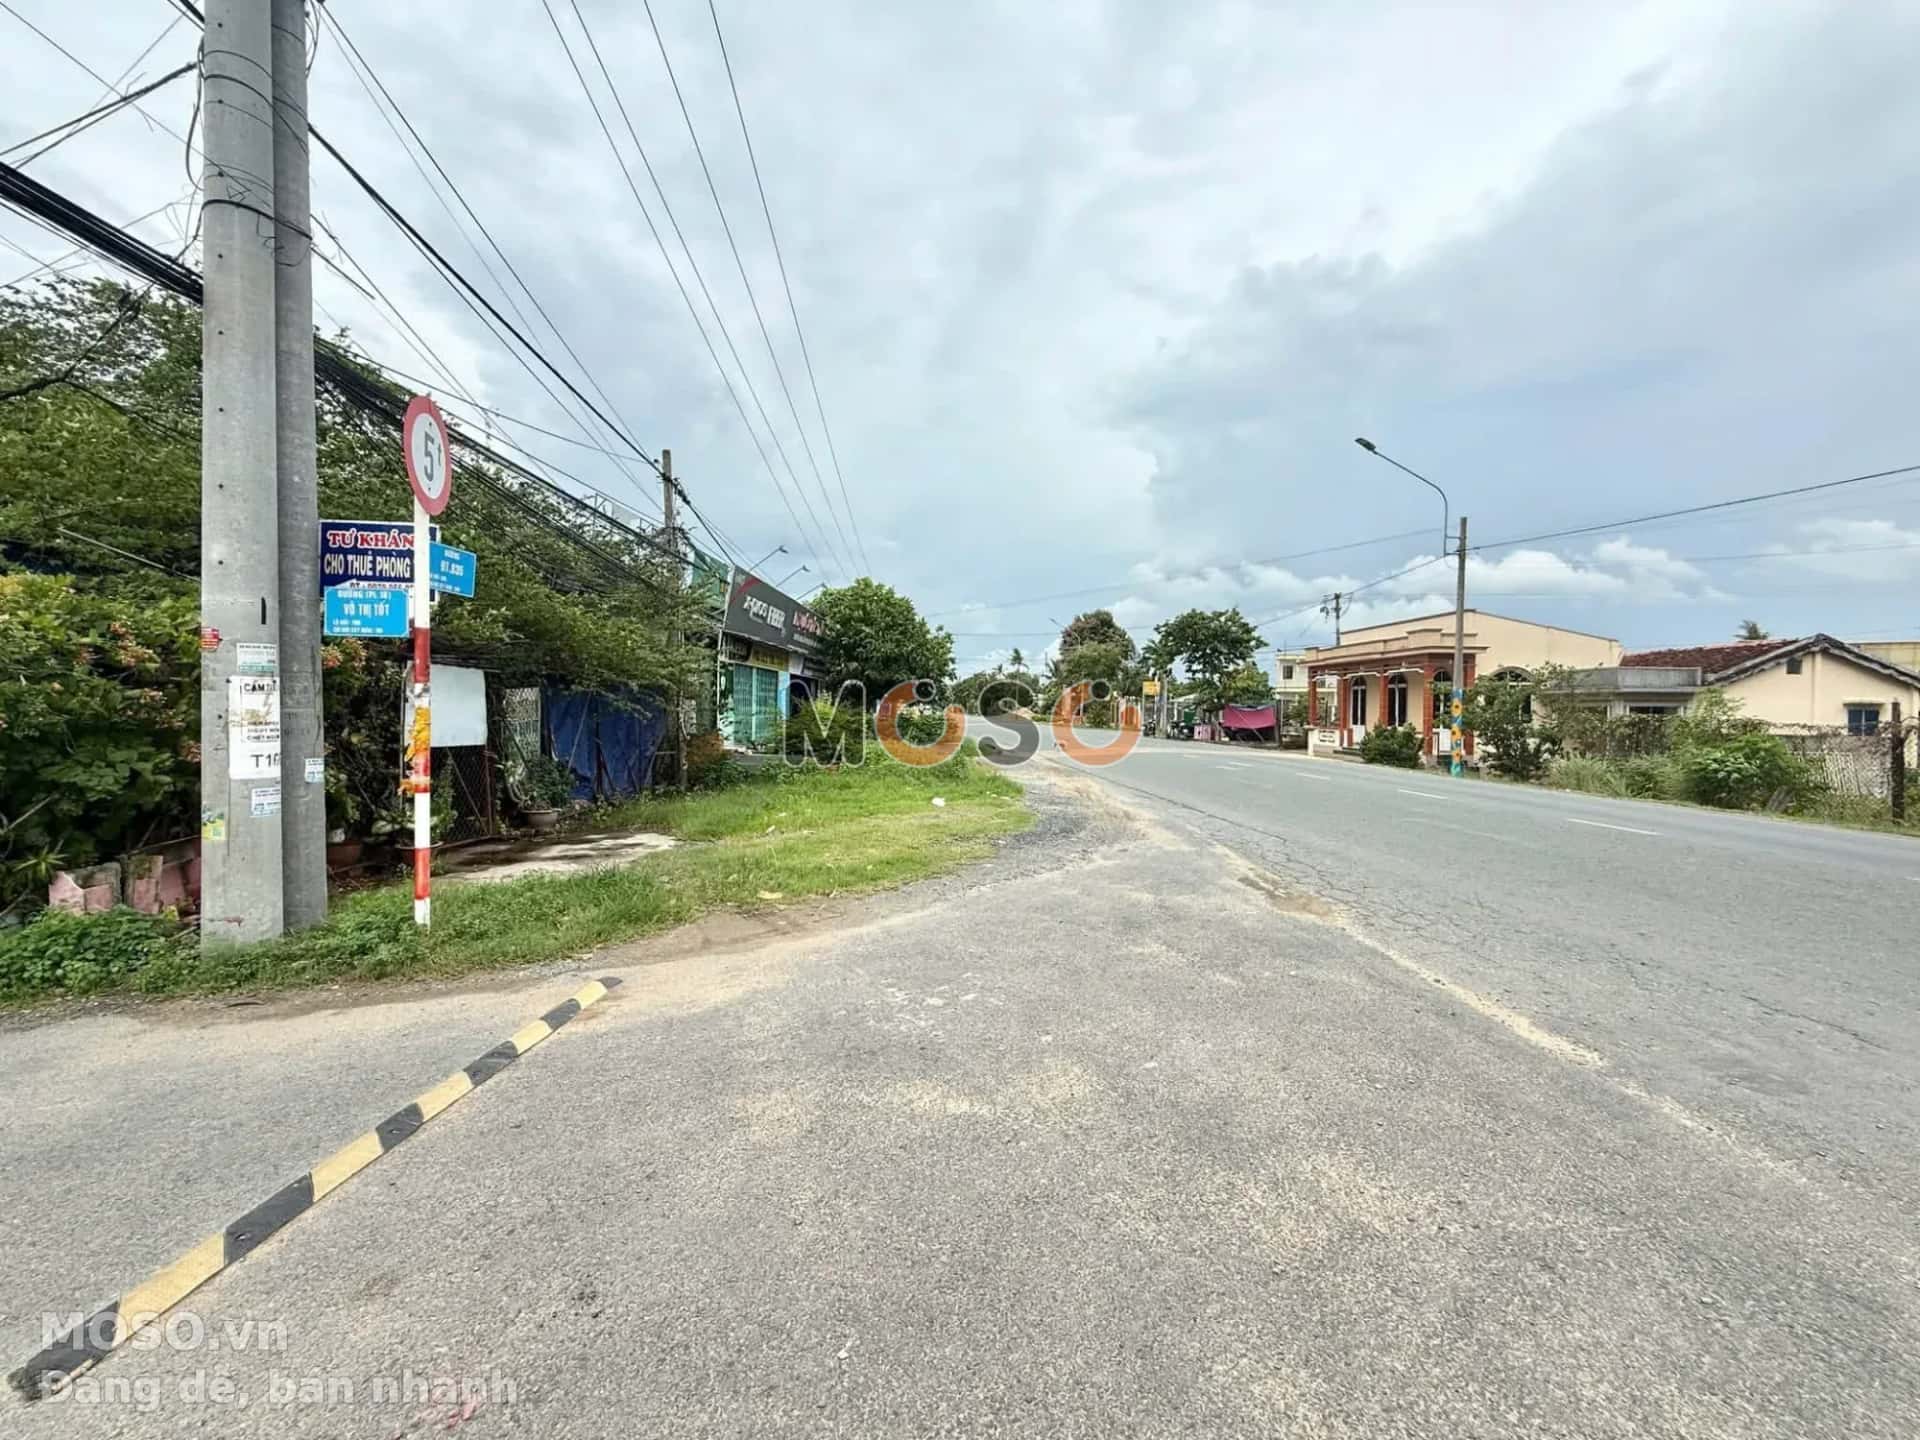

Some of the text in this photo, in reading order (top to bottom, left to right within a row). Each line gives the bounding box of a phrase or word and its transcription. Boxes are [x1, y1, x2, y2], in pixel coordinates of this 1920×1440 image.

[327, 528, 415, 550] TƯ KHÁN
[324, 553, 344, 575] CHO
[376, 551, 411, 578] PHÒNG
[358, 603, 372, 619] THỊ
[243, 680, 265, 692] CẤM
